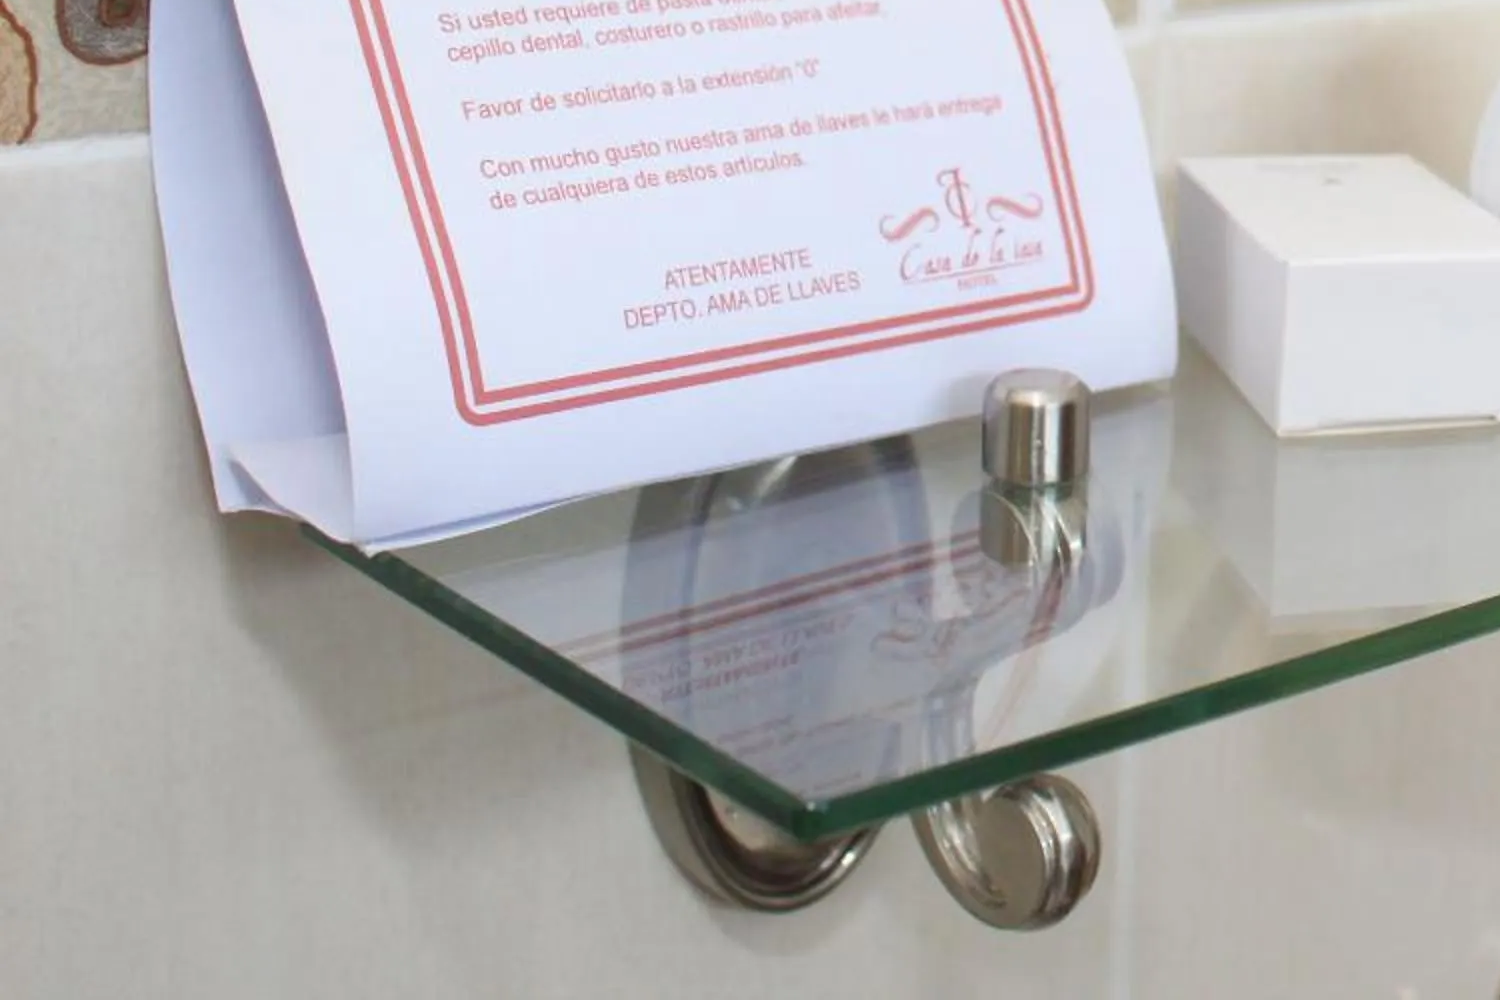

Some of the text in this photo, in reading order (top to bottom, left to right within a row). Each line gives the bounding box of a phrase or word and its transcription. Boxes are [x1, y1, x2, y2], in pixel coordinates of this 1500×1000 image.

[437, 13, 461, 33] Si
[467, 6, 528, 30] usted
[534, 0, 620, 28] requiere
[447, 36, 515, 63] cepillo
[594, 20, 687, 46] costurero
[691, 20, 705, 36] o
[709, 10, 777, 34] rastrillo
[781, 6, 823, 29] para
[461, 98, 524, 121] Favor
[530, 91, 557, 113] de
[562, 81, 656, 109] solicitarlo
[661, 80, 674, 96] a
[678, 75, 697, 94] la
[701, 63, 793, 92] extensión
[479, 158, 525, 180] Con
[530, 147, 600, 174] mucho
[605, 139, 661, 167] gusto
[665, 129, 739, 156] nuestra
[744, 123, 785, 144] ama
[790, 117, 813, 138] de
[817, 109, 870, 133] llaves
[872, 107, 890, 126] le
[937, 94, 1002, 118] entrega
[489, 190, 518, 211] de
[522, 175, 630, 206] cualquiera
[634, 169, 660, 190] de
[665, 163, 719, 185] estos
[664, 247, 813, 291] ATENTAMENTE
[623, 271, 862, 331] DEPTO. AMA DE LLAVES
